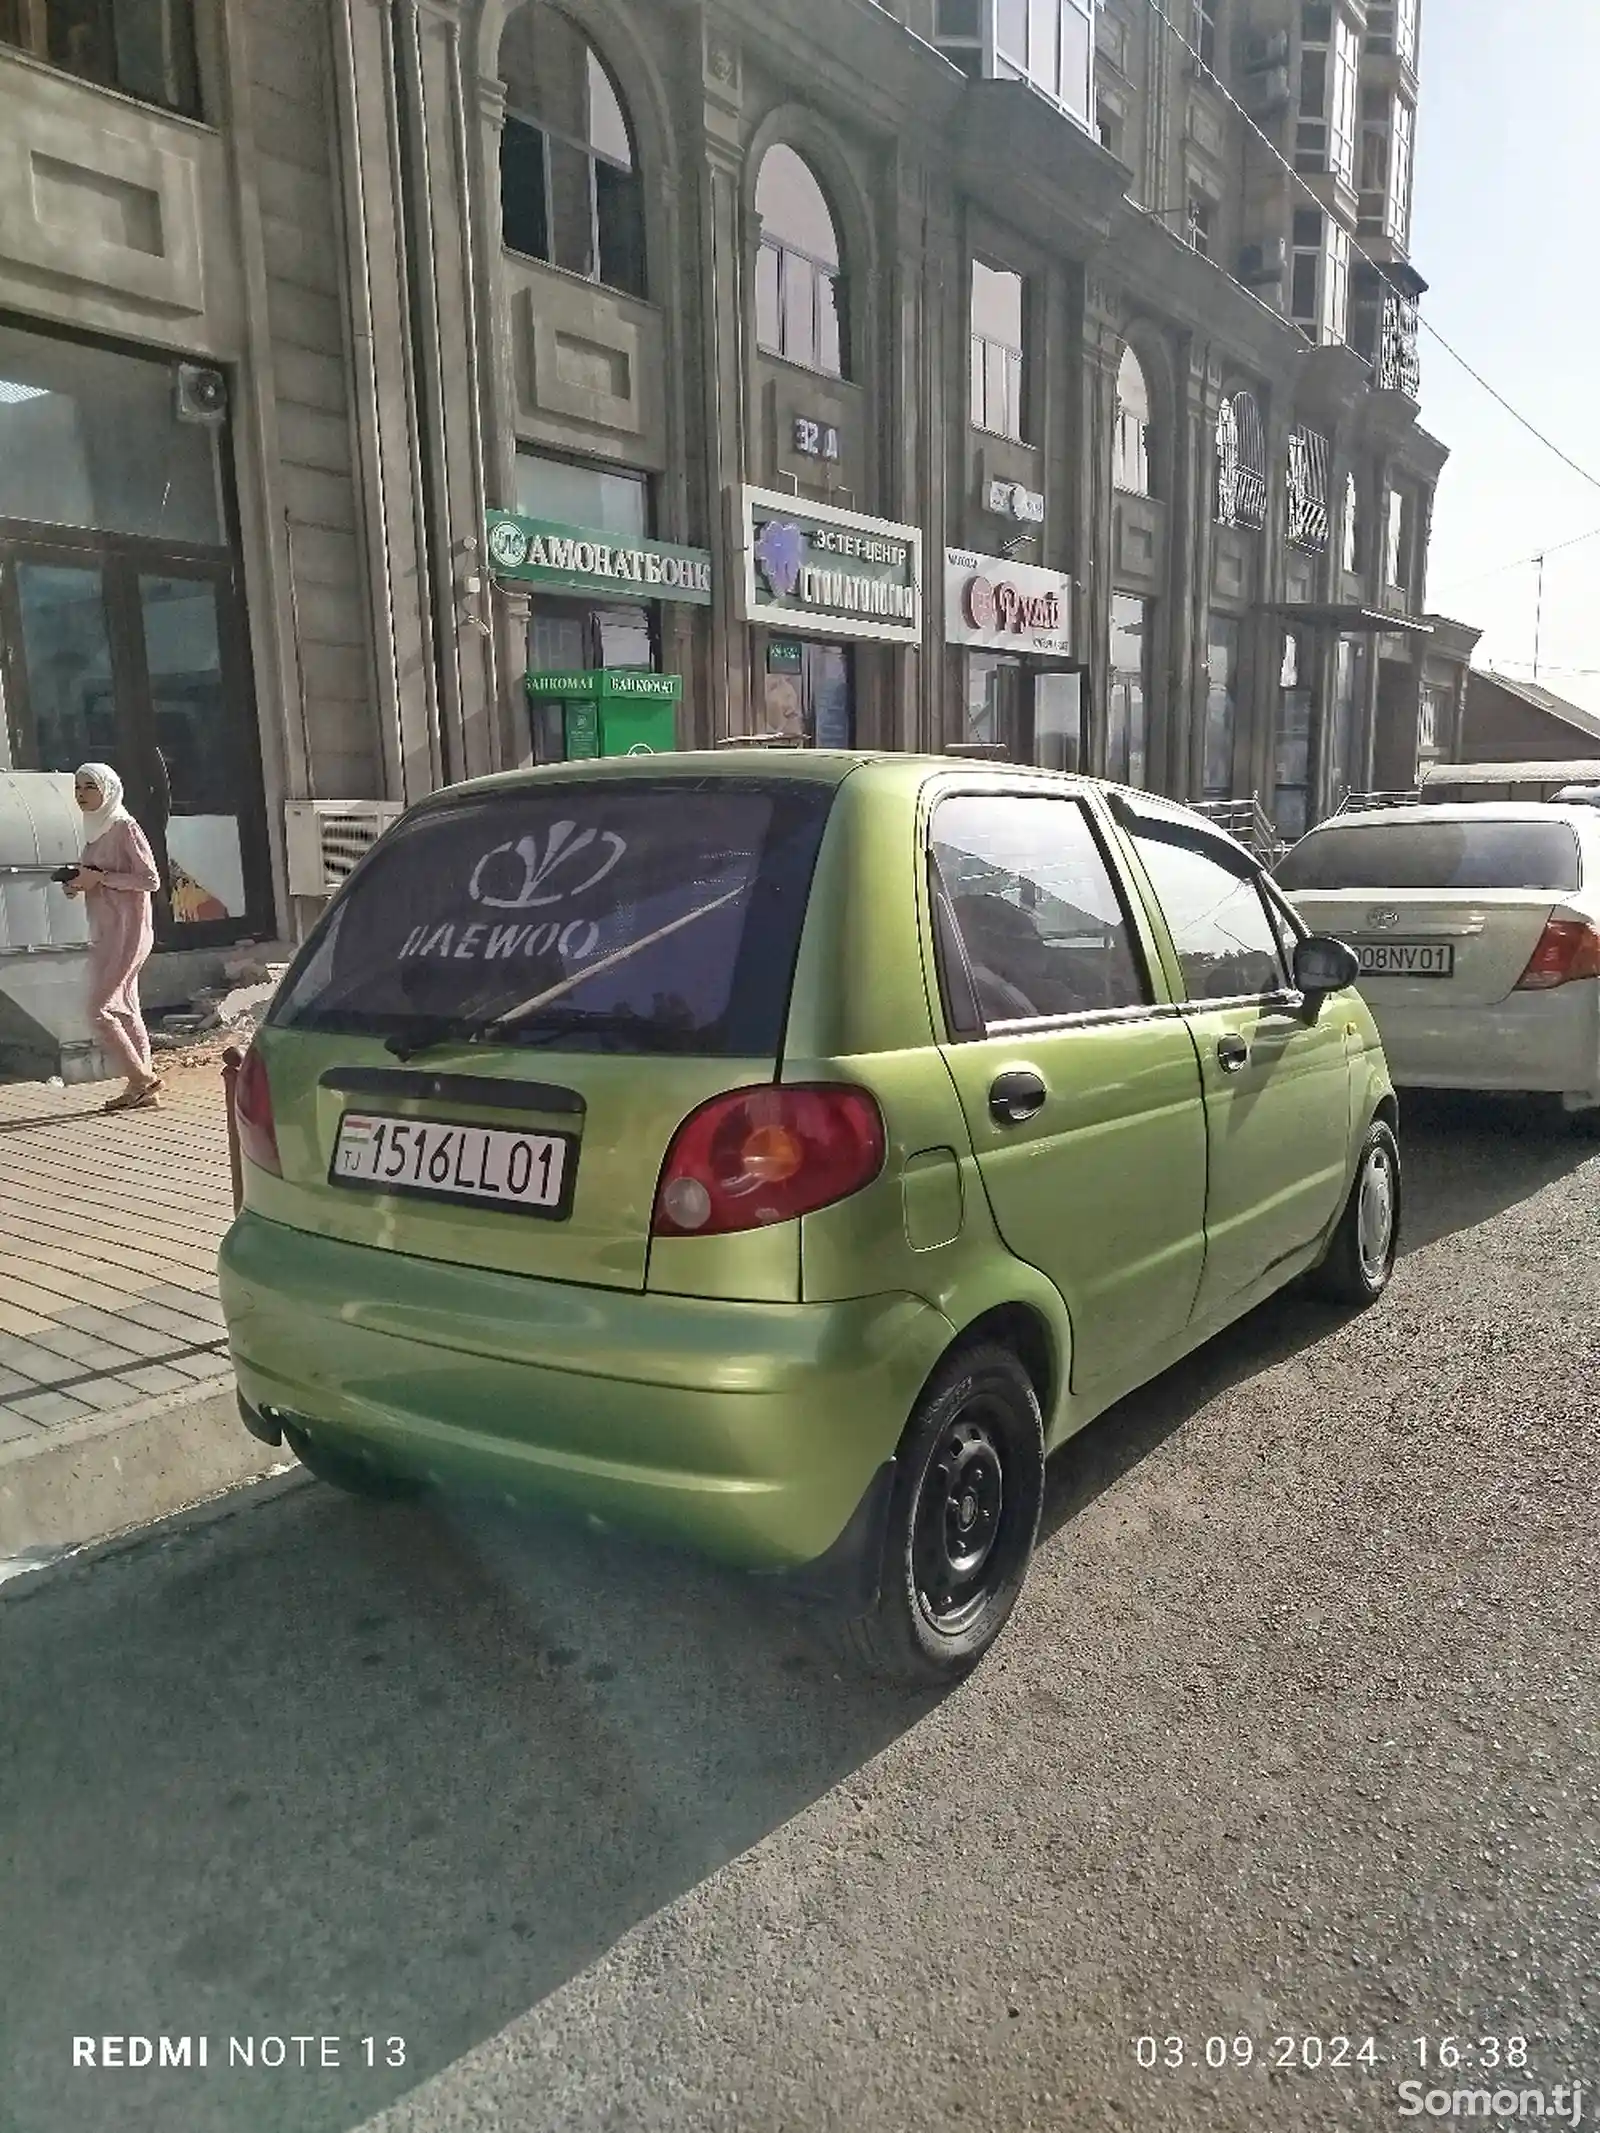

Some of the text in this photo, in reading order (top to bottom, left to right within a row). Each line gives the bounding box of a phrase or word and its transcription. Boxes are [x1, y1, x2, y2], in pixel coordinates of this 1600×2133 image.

[795, 418, 819, 455] 32
[526, 534, 712, 592] АМОНАТБОНК
[815, 528, 907, 566] ЭСТЕТ-ЦЕНТР
[802, 566, 914, 619] СТОМАТОЛОГИЯ
[610, 676, 675, 694] БАНКОМАТ
[397, 919, 601, 961] DAEWOO
[342, 1123, 554, 1200] TJ 1516LL01
